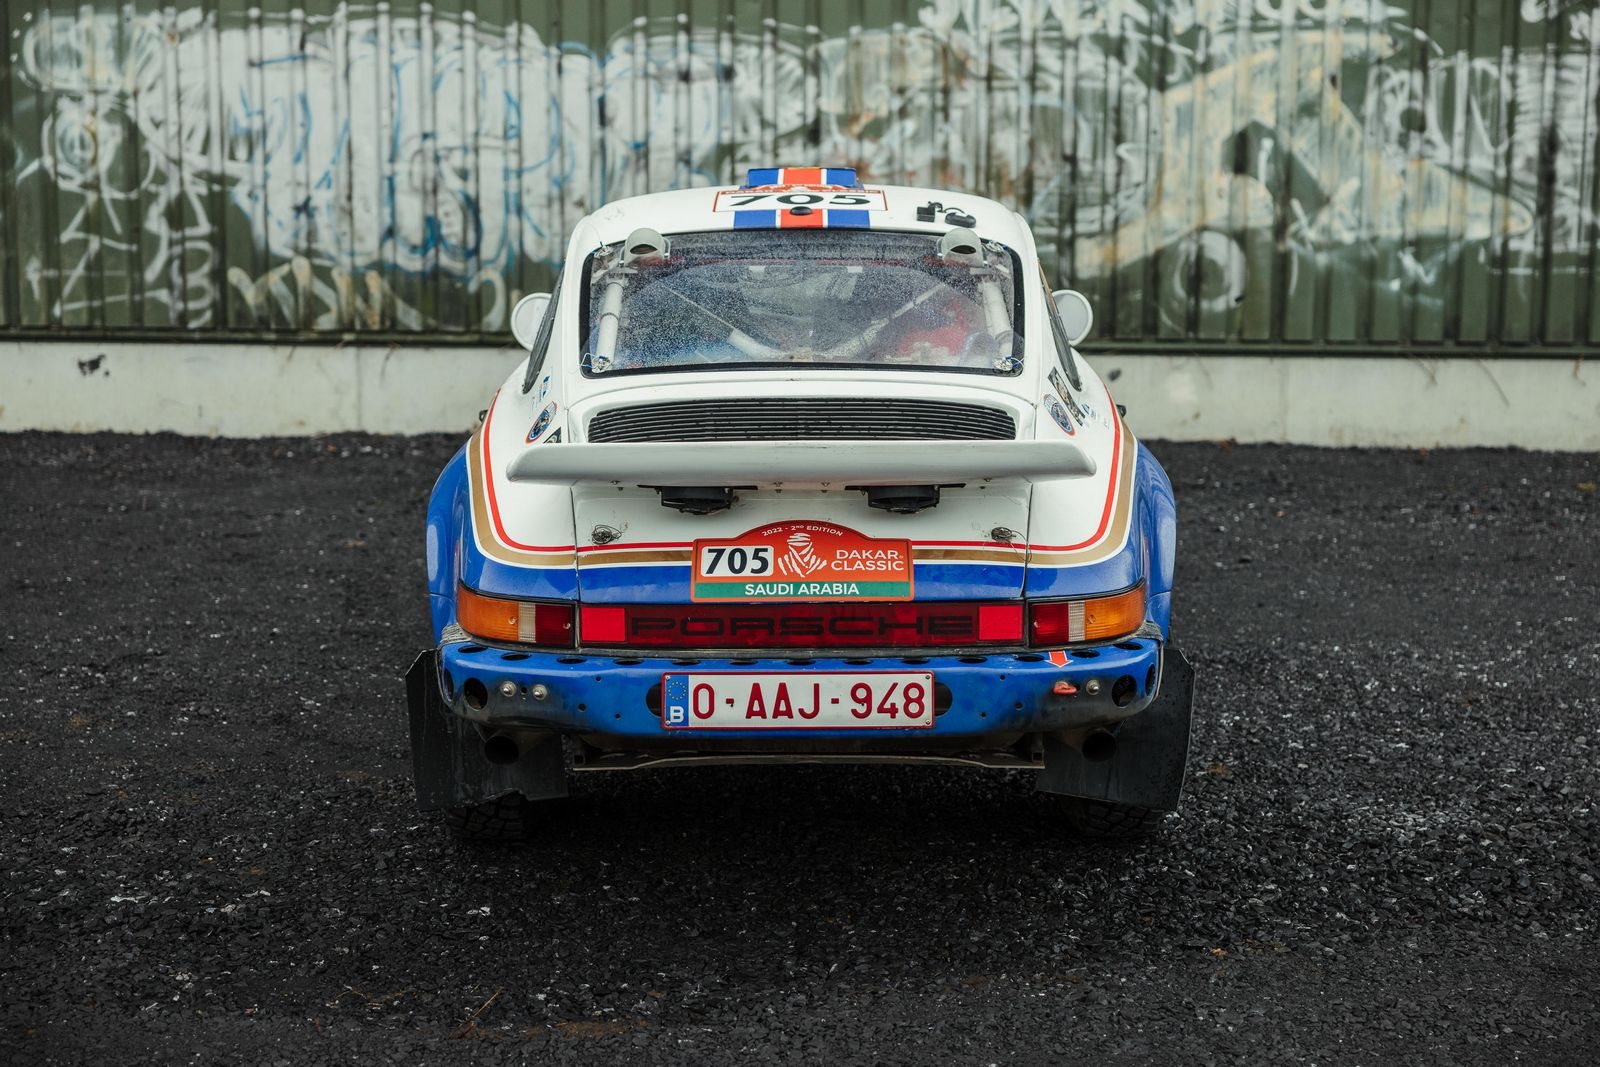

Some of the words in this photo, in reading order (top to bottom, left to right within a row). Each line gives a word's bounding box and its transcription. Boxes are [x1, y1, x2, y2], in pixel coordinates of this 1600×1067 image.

[730, 194, 871, 207] 705
[761, 526, 783, 537] 2022
[806, 525, 843, 537] EDITION
[705, 547, 769, 575] 705
[836, 549, 899, 560] DAKAR
[831, 560, 905, 572] CLASSIC
[744, 583, 794, 596] SAUDI
[798, 583, 860, 596] ARABIA
[631, 616, 974, 636] PORSCHE
[669, 705, 685, 723] B
